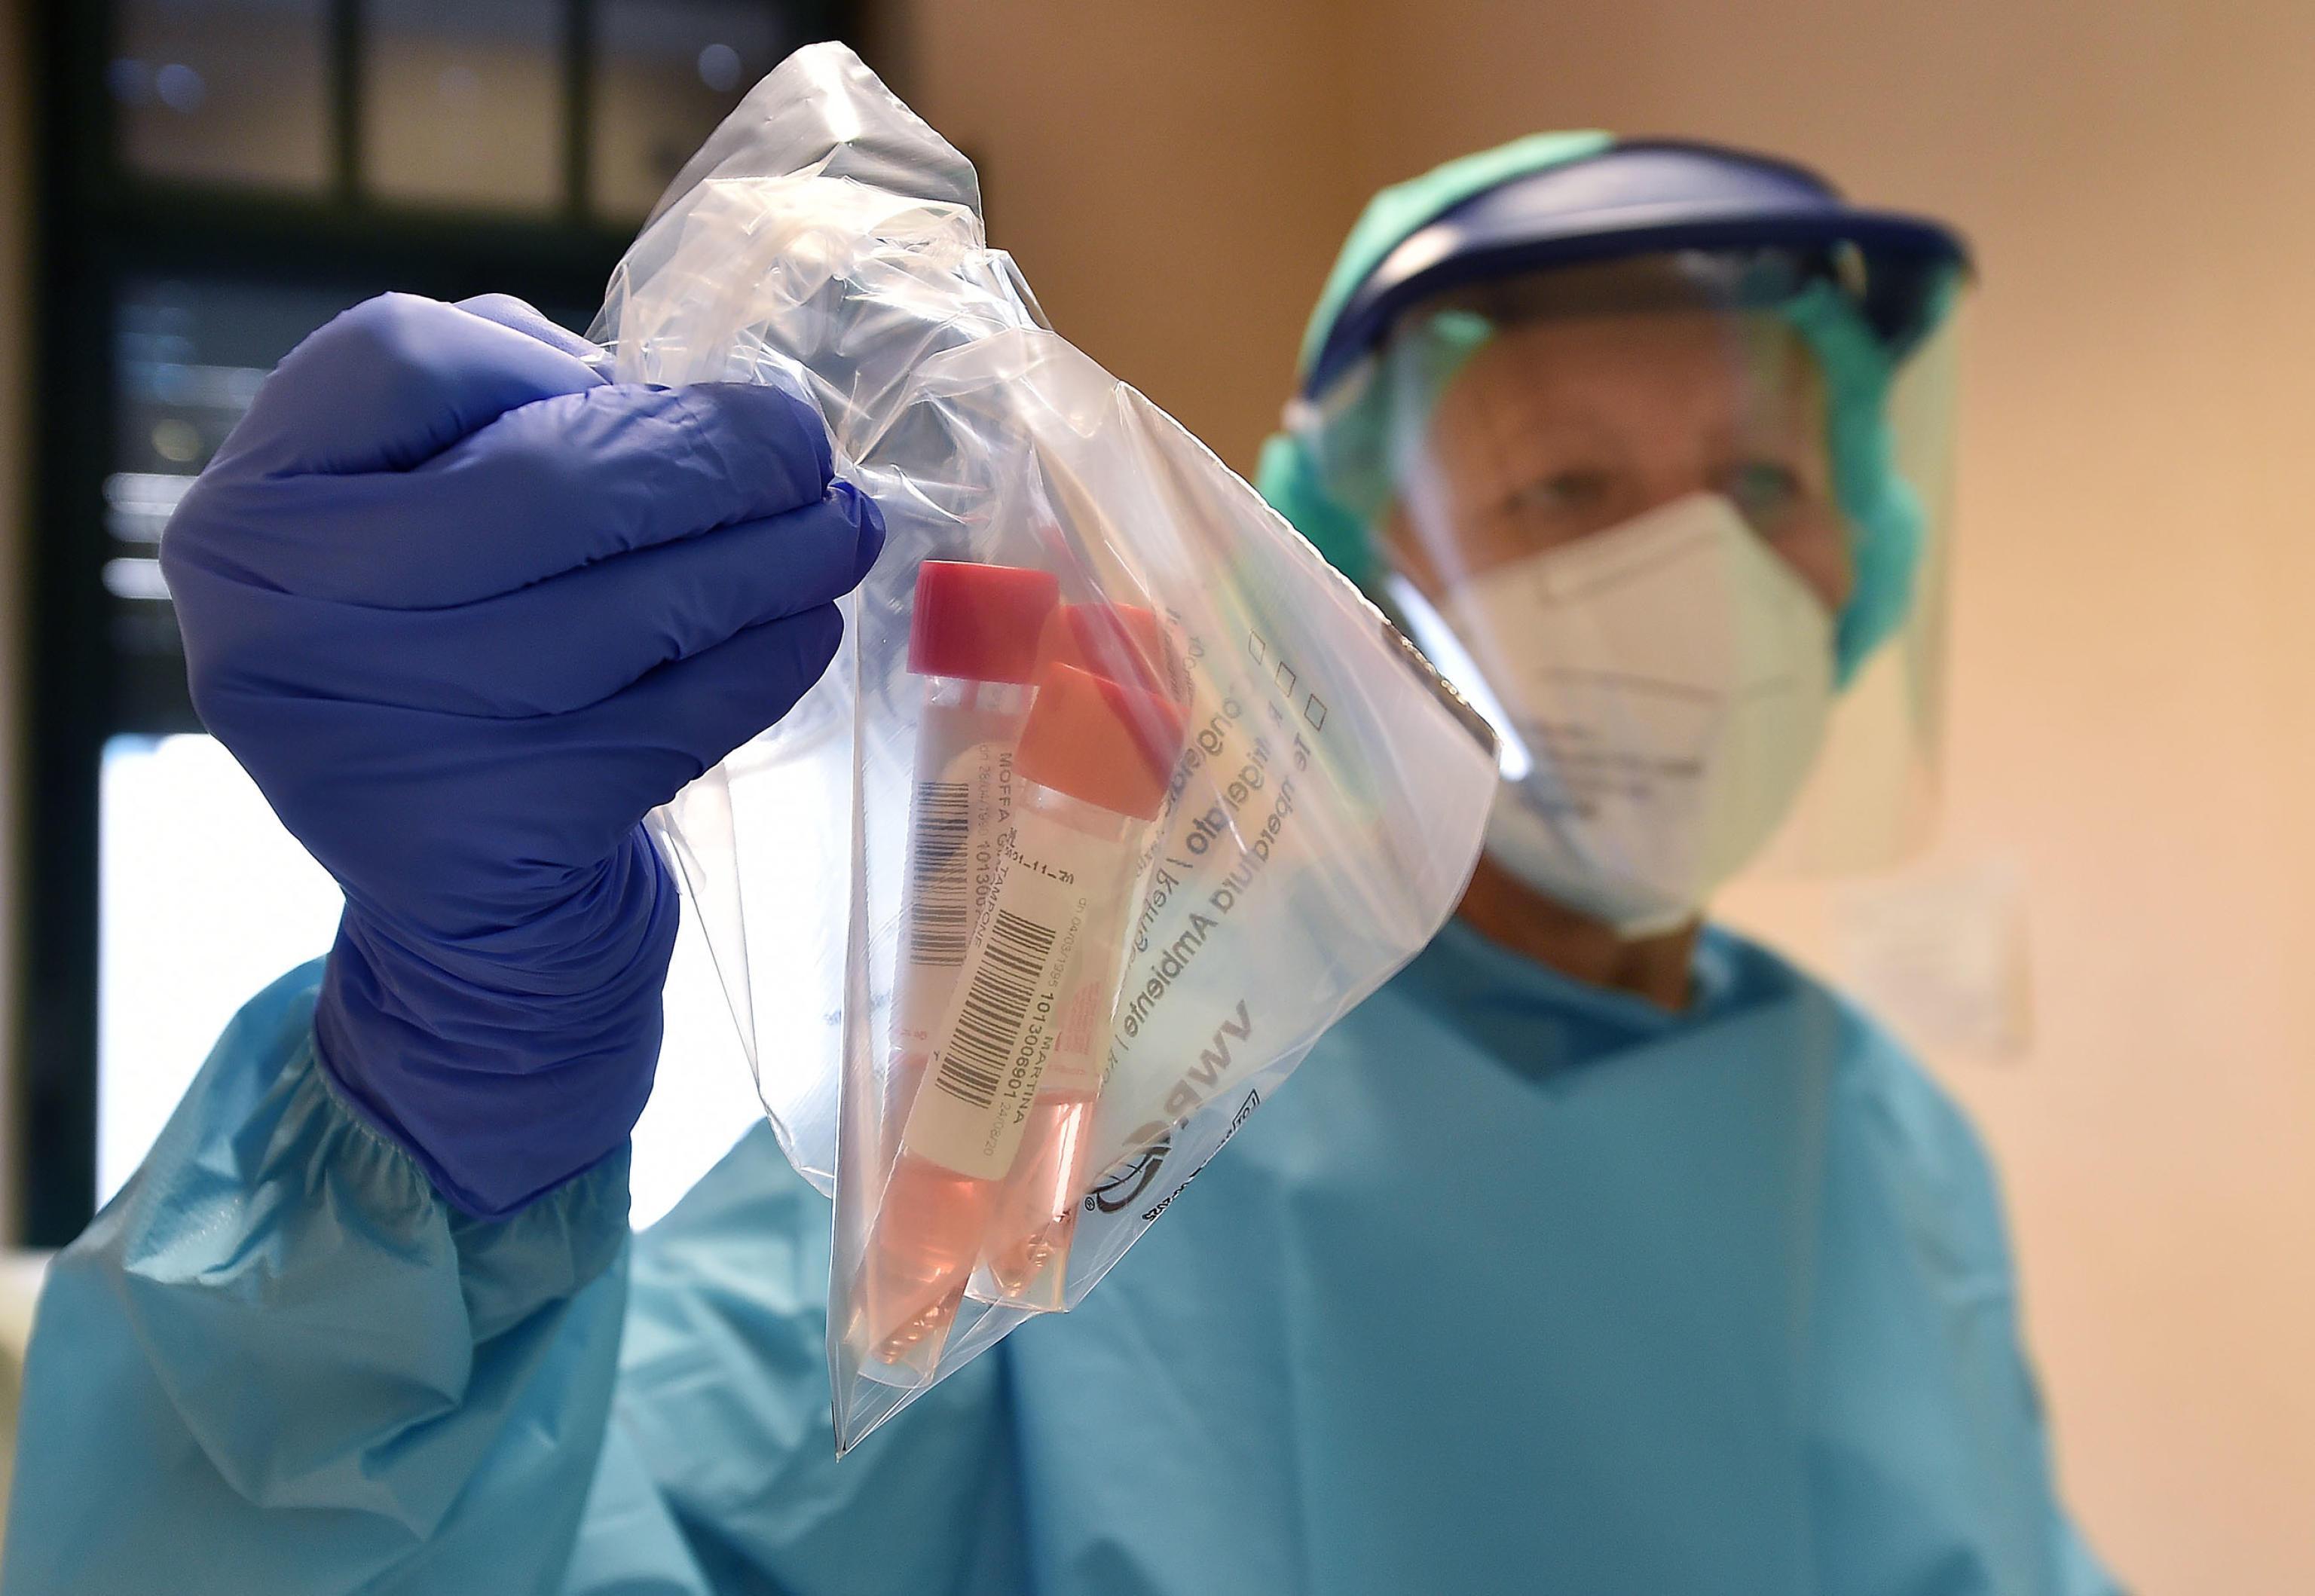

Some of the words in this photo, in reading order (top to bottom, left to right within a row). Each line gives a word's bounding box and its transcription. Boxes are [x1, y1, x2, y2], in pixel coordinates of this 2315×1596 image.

[997, 753, 1013, 823] MOFFA
[971, 867, 1009, 948] TAMPONE
[1003, 992, 1055, 1099] 1013006901
[1013, 1036, 1054, 1124] MARTINA
